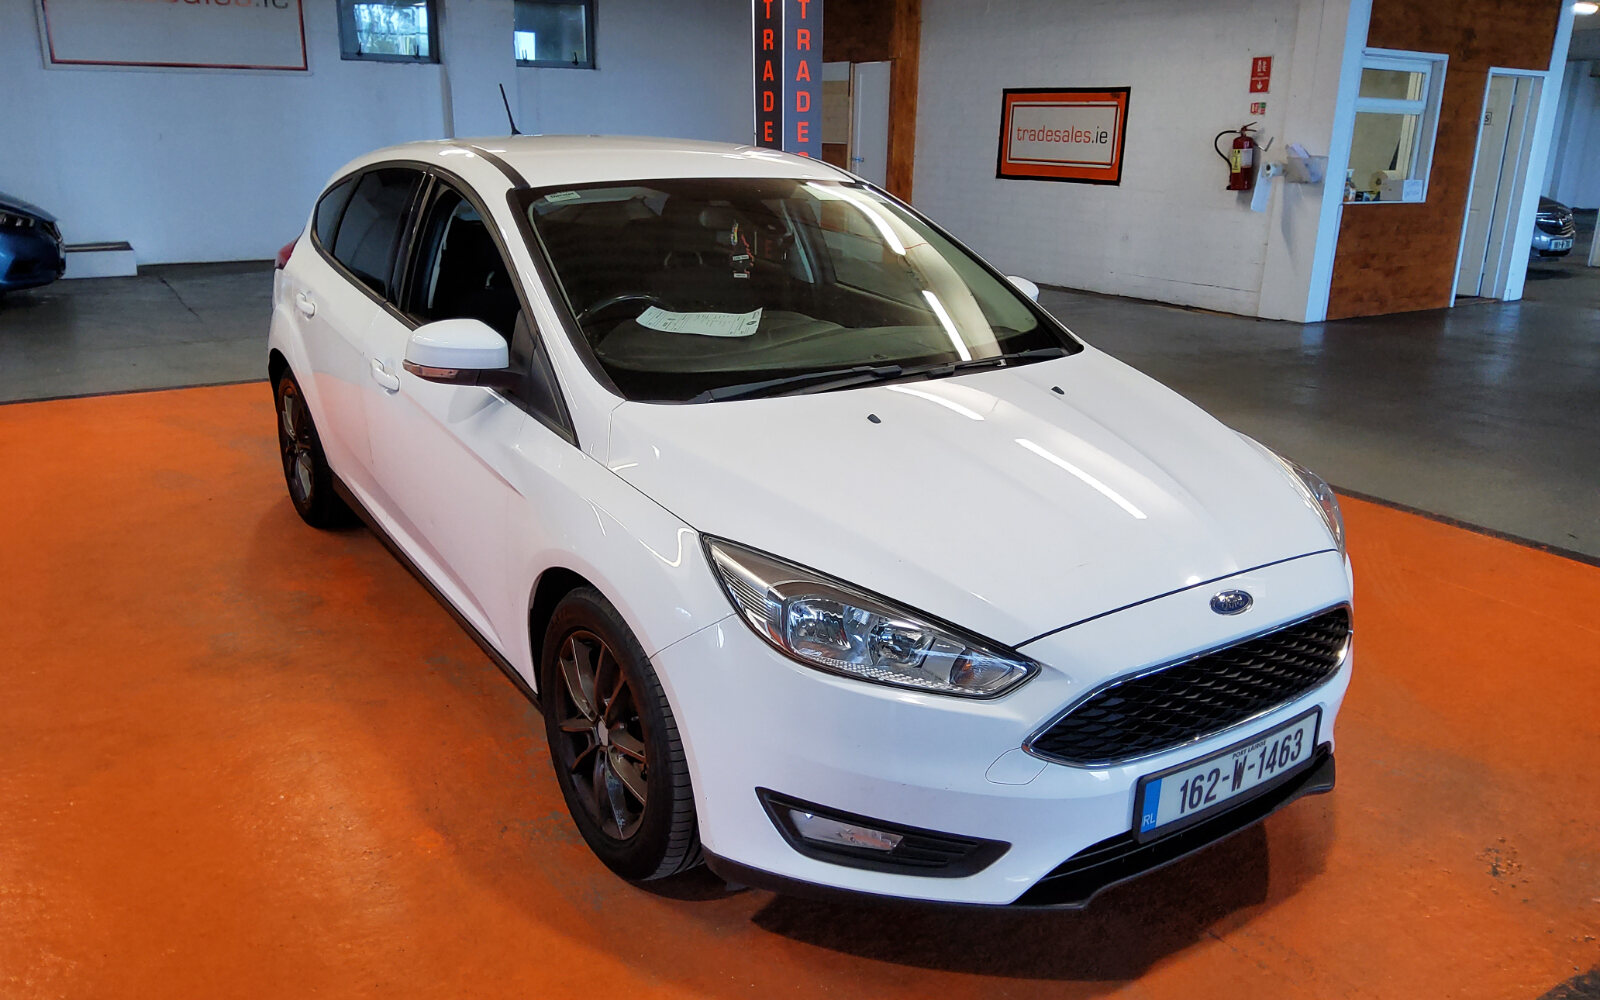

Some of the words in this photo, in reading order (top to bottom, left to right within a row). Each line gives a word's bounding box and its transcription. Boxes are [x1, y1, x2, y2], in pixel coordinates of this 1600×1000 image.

[796, 0, 811, 157] TRADE
[1016, 125, 1108, 144] tradesales.ie
[1180, 728, 1304, 814] 162-W-1463
[1232, 748, 1247, 759] PORT
